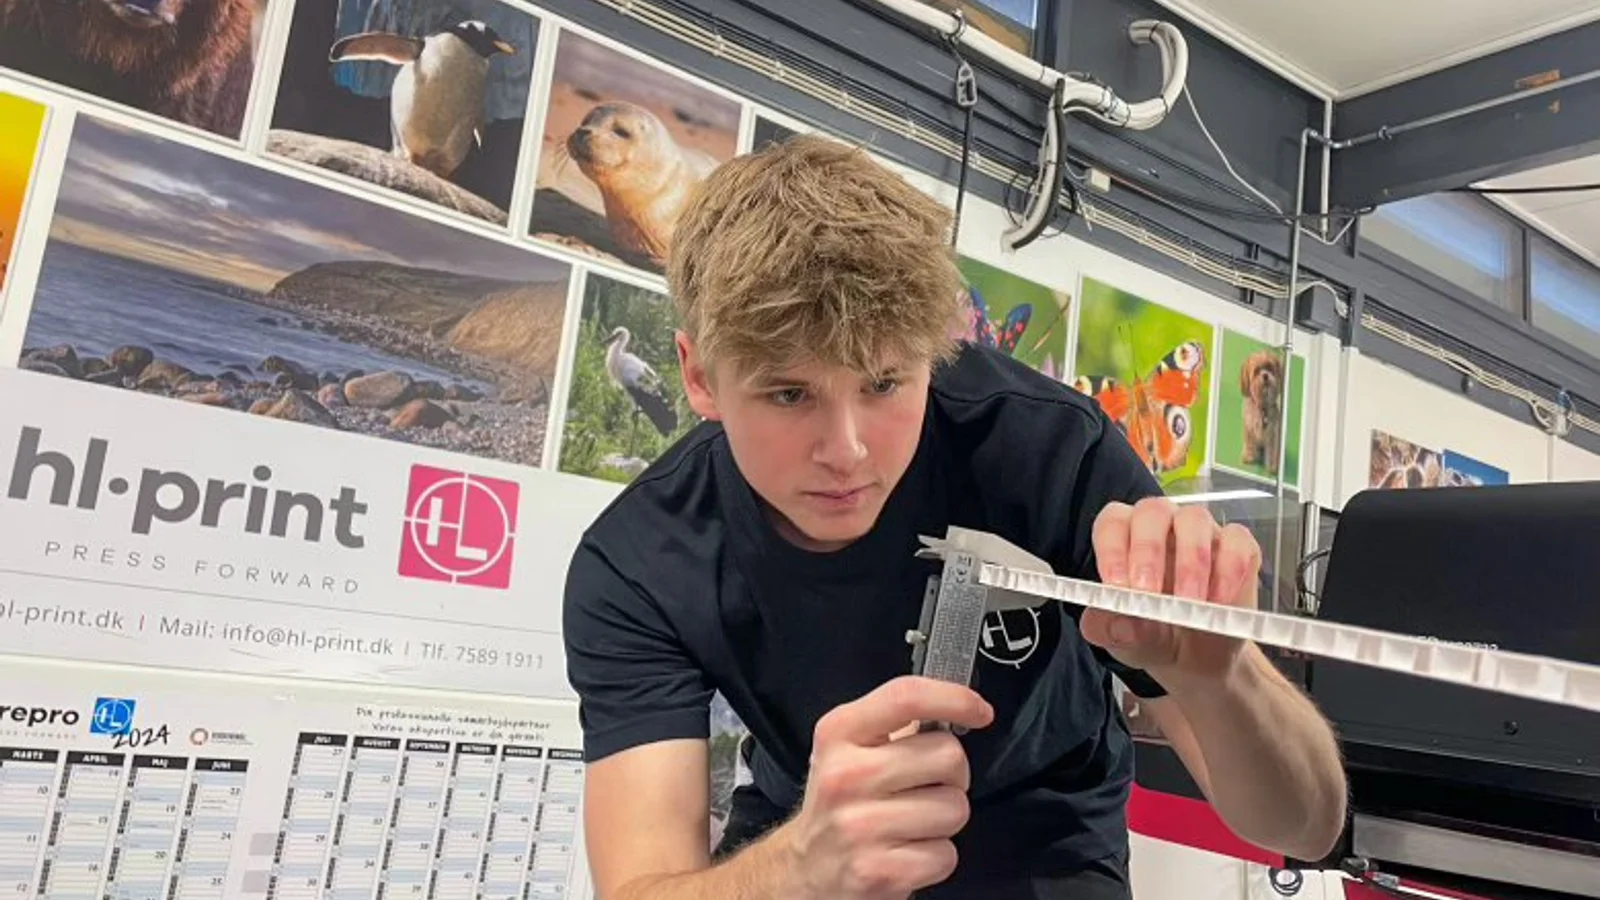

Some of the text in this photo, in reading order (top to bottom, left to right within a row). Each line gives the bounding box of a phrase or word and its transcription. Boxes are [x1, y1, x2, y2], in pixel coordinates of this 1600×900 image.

[45, 540, 360, 594] PRESS FORWARD
[159, 616, 215, 640] Mail:
[221, 622, 393, 657] info@hl-print.dk
[421, 641, 448, 661] Tlf.
[456, 646, 498, 667] 7589
[505, 650, 544, 669] 1911
[112, 723, 170, 749] 2024
